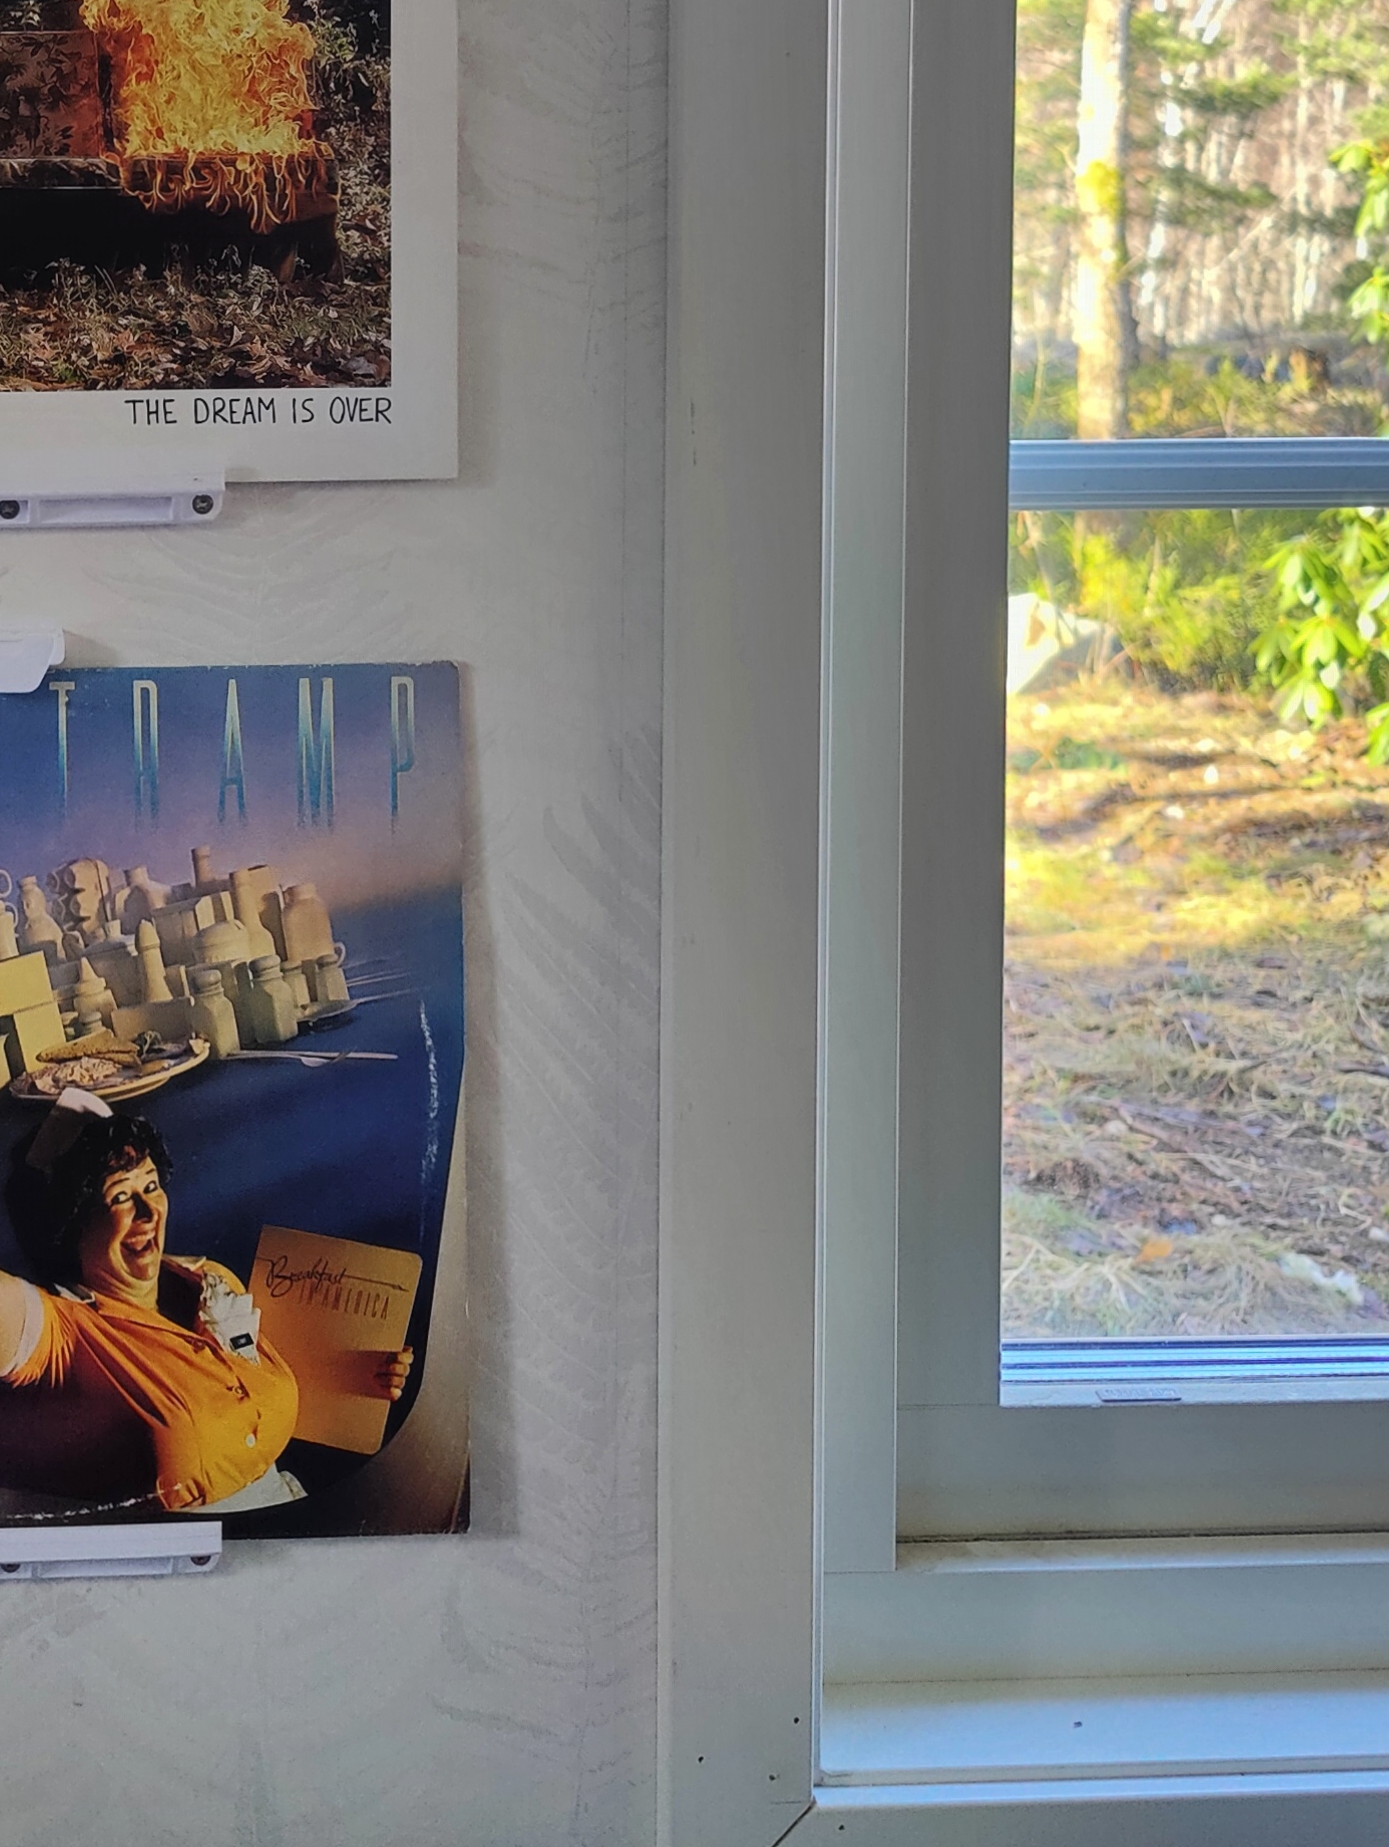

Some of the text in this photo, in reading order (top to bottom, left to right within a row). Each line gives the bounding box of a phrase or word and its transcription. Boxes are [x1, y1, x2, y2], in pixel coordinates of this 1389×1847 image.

[124, 396, 392, 425] THE DREAM IS OVER
[265, 1255, 347, 1298] Breakfast
[321, 1282, 390, 1320] AMERICA
